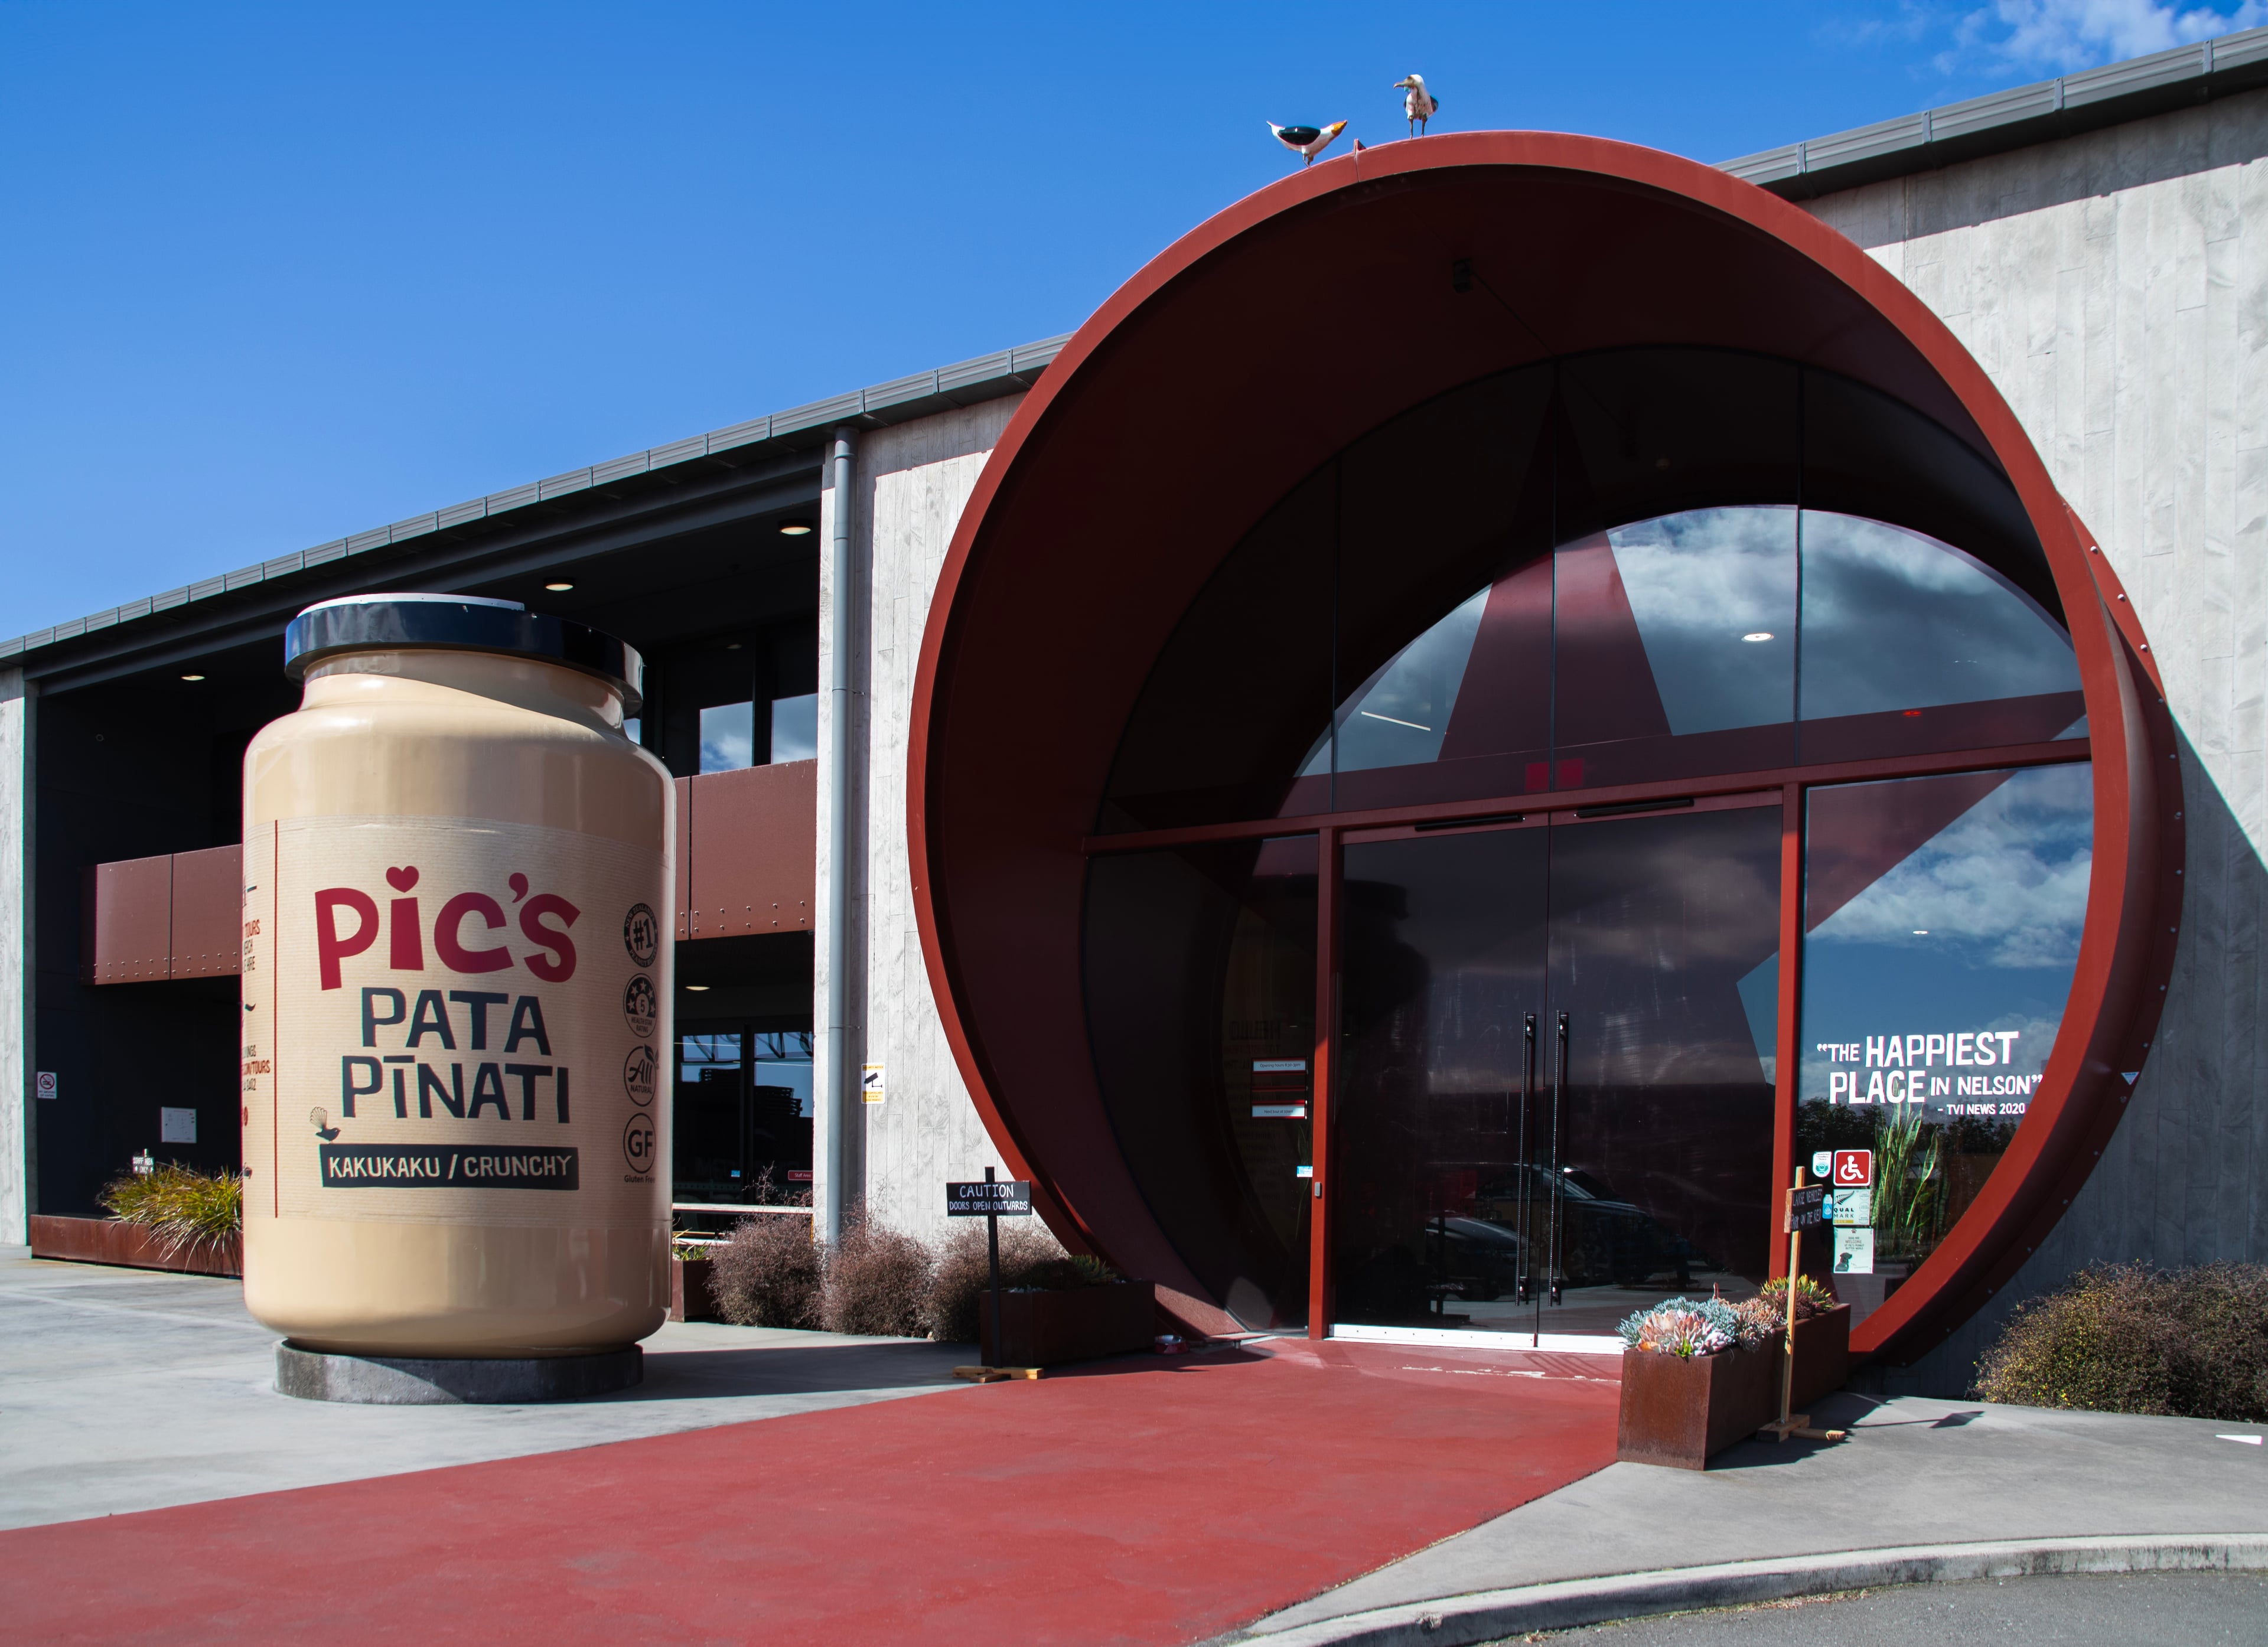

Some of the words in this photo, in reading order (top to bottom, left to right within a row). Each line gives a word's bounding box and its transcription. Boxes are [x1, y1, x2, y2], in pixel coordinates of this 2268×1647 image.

[633, 918, 653, 951] #1
[640, 999, 646, 1013] 5
[362, 987, 552, 1056] PATA
[631, 1016, 644, 1025] HEALTH
[1865, 1031, 2020, 1068] HAPPIEST
[628, 1058, 653, 1085] All
[630, 1084, 653, 1094] NATURAL
[1829, 1070, 1927, 1104] PLACE
[1930, 1077, 1950, 1097] IN
[1966, 1103, 1996, 1116] NEWS
[1999, 1102, 2026, 1115] 2020
[628, 1129, 653, 1158] GF
[329, 1156, 440, 1179] KAKUKAKU
[449, 1154, 458, 1180] /
[464, 1154, 573, 1178] CRUNCHY
[624, 1175, 644, 1183] Gluten
[959, 1184, 1014, 1198] CAUTION
[949, 1201, 970, 1211] DOORS
[973, 1201, 990, 1211] OPEN
[993, 1201, 1028, 1211] OUTWARDS
